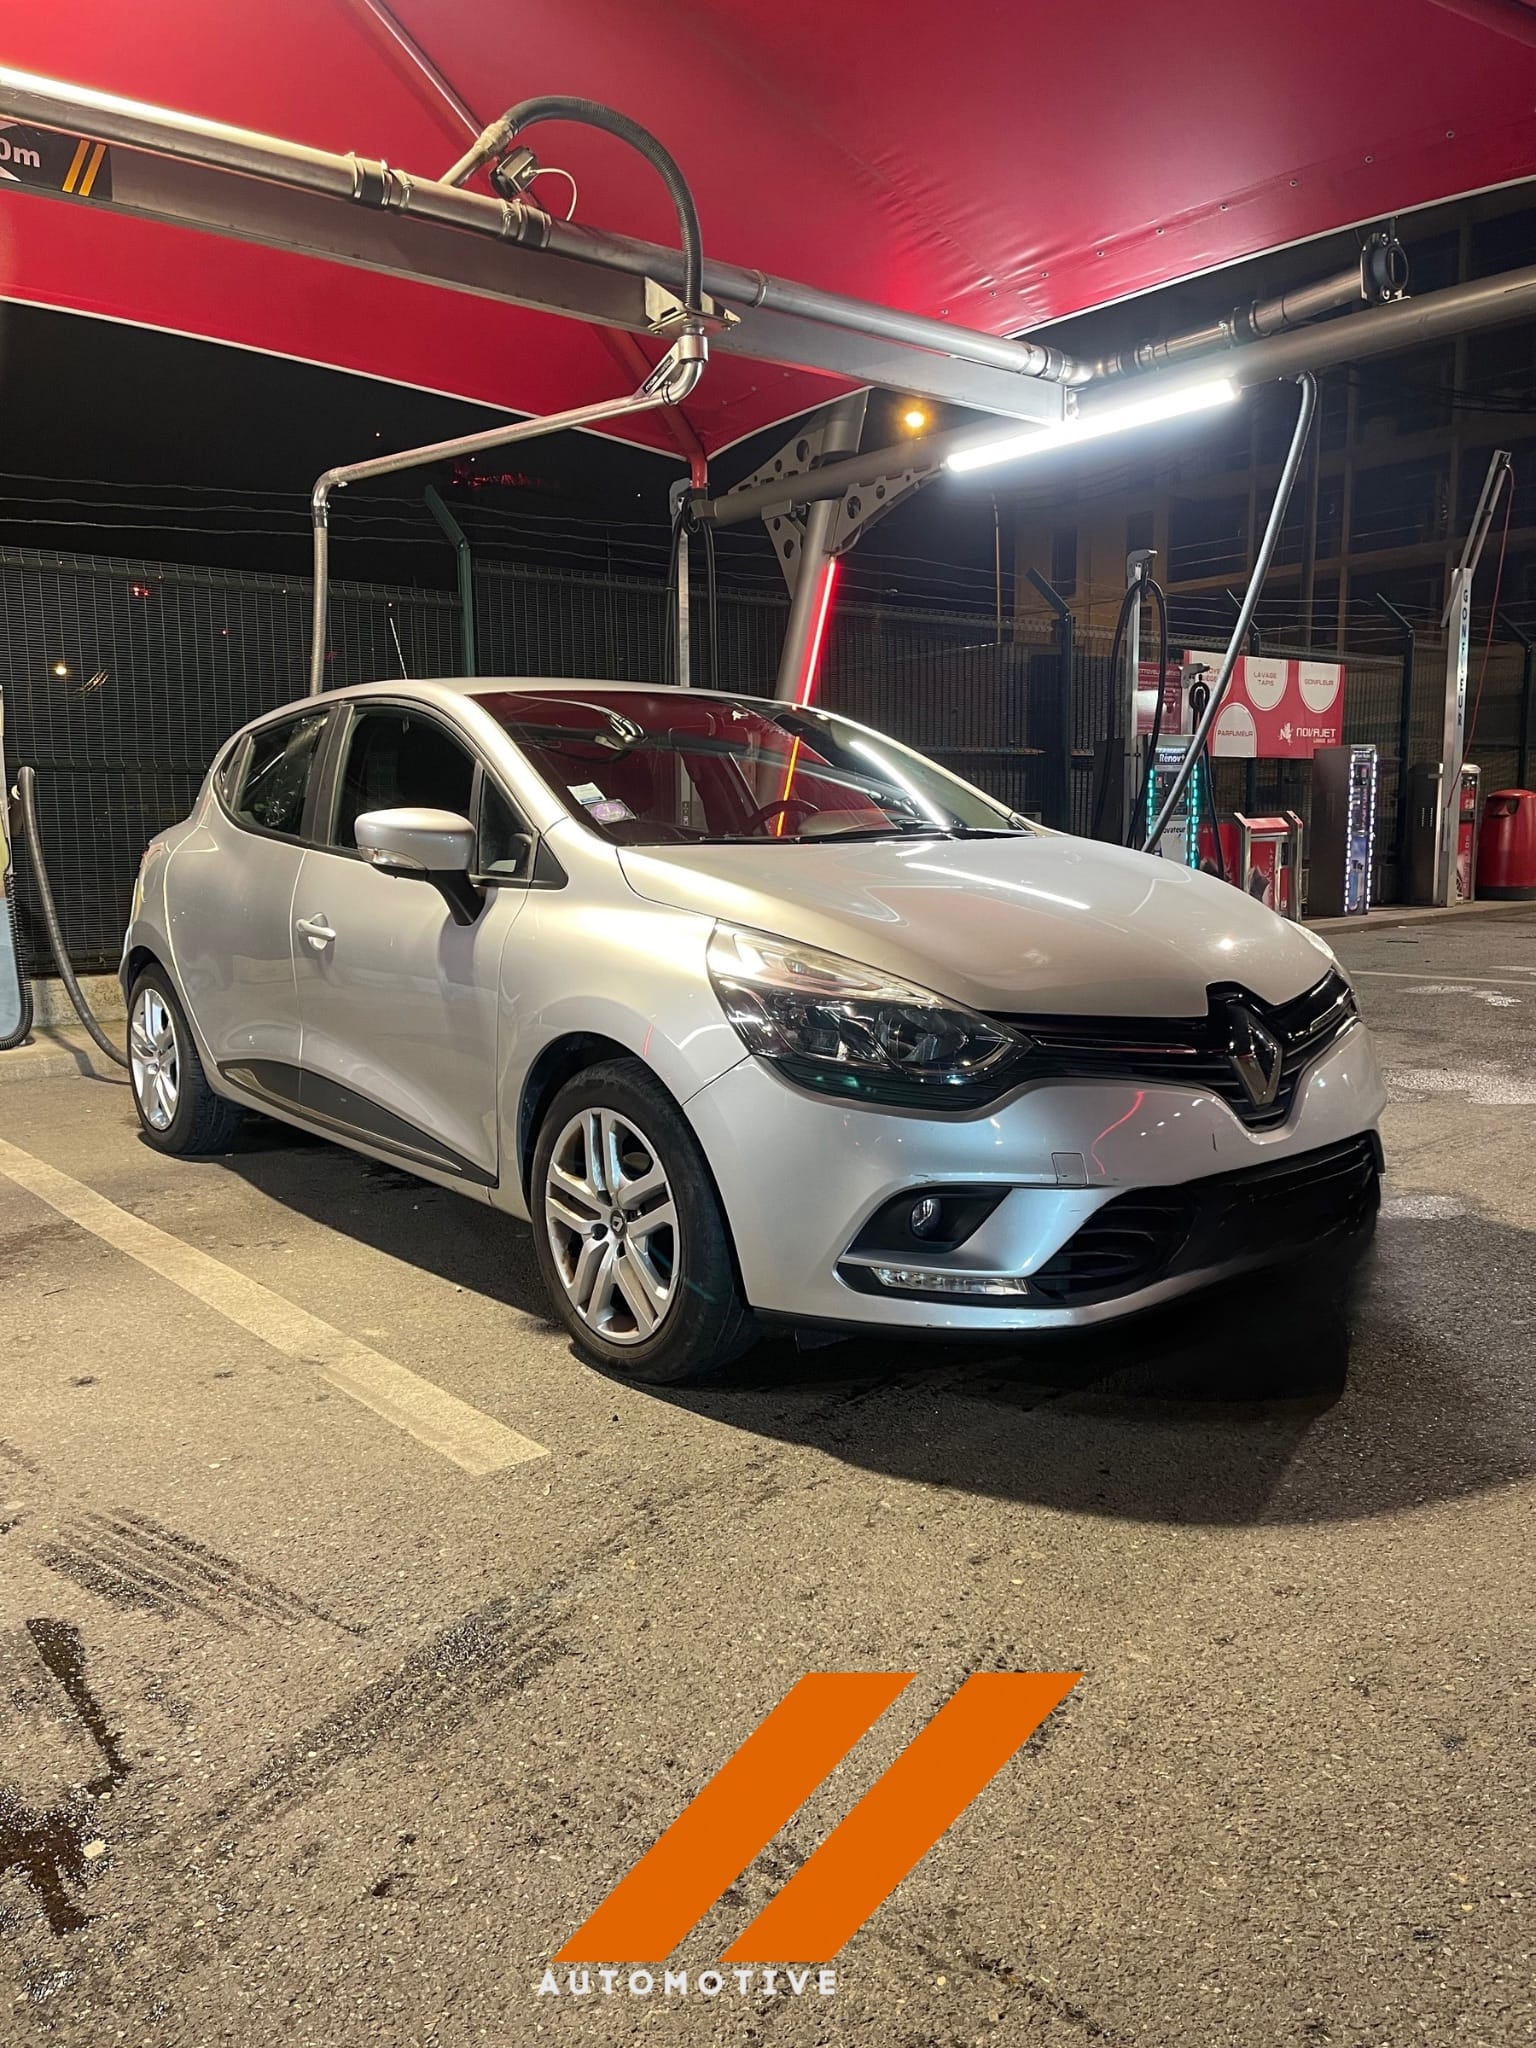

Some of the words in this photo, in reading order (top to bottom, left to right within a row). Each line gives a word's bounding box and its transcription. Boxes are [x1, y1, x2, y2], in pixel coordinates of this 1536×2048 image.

[1253, 671, 1277, 679] LAVAGE
[1258, 679, 1274, 687] TAPIS
[1304, 678, 1334, 686] GONFLEUR
[1217, 729, 1253, 737] PARFUMEUR
[1296, 727, 1337, 738] NOVAJET
